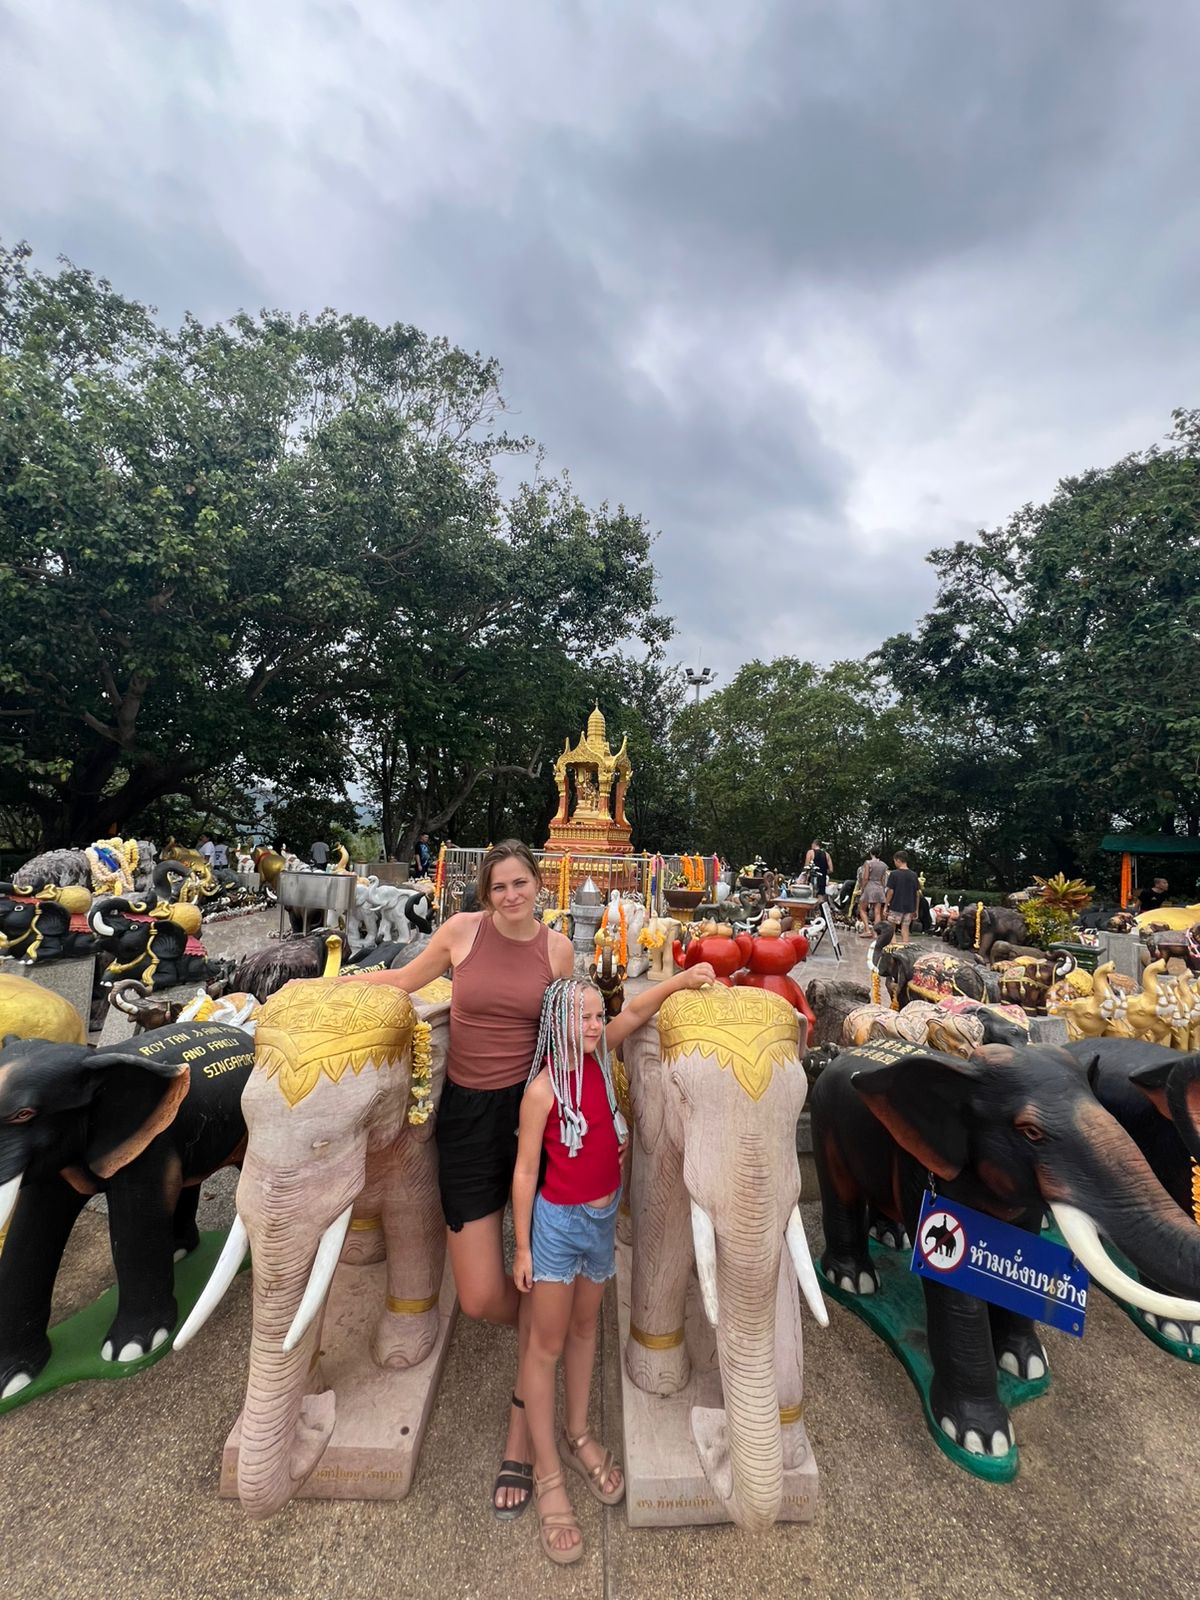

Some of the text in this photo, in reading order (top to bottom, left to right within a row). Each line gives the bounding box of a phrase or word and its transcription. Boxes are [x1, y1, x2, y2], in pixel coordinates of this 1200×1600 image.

[139, 1040, 166, 1056] ROY
[164, 1033, 191, 1045] TAN
[182, 1038, 240, 1062] AND FAMILY
[970, 1240, 1087, 1307] ห้ามนั่งบนช้าง
